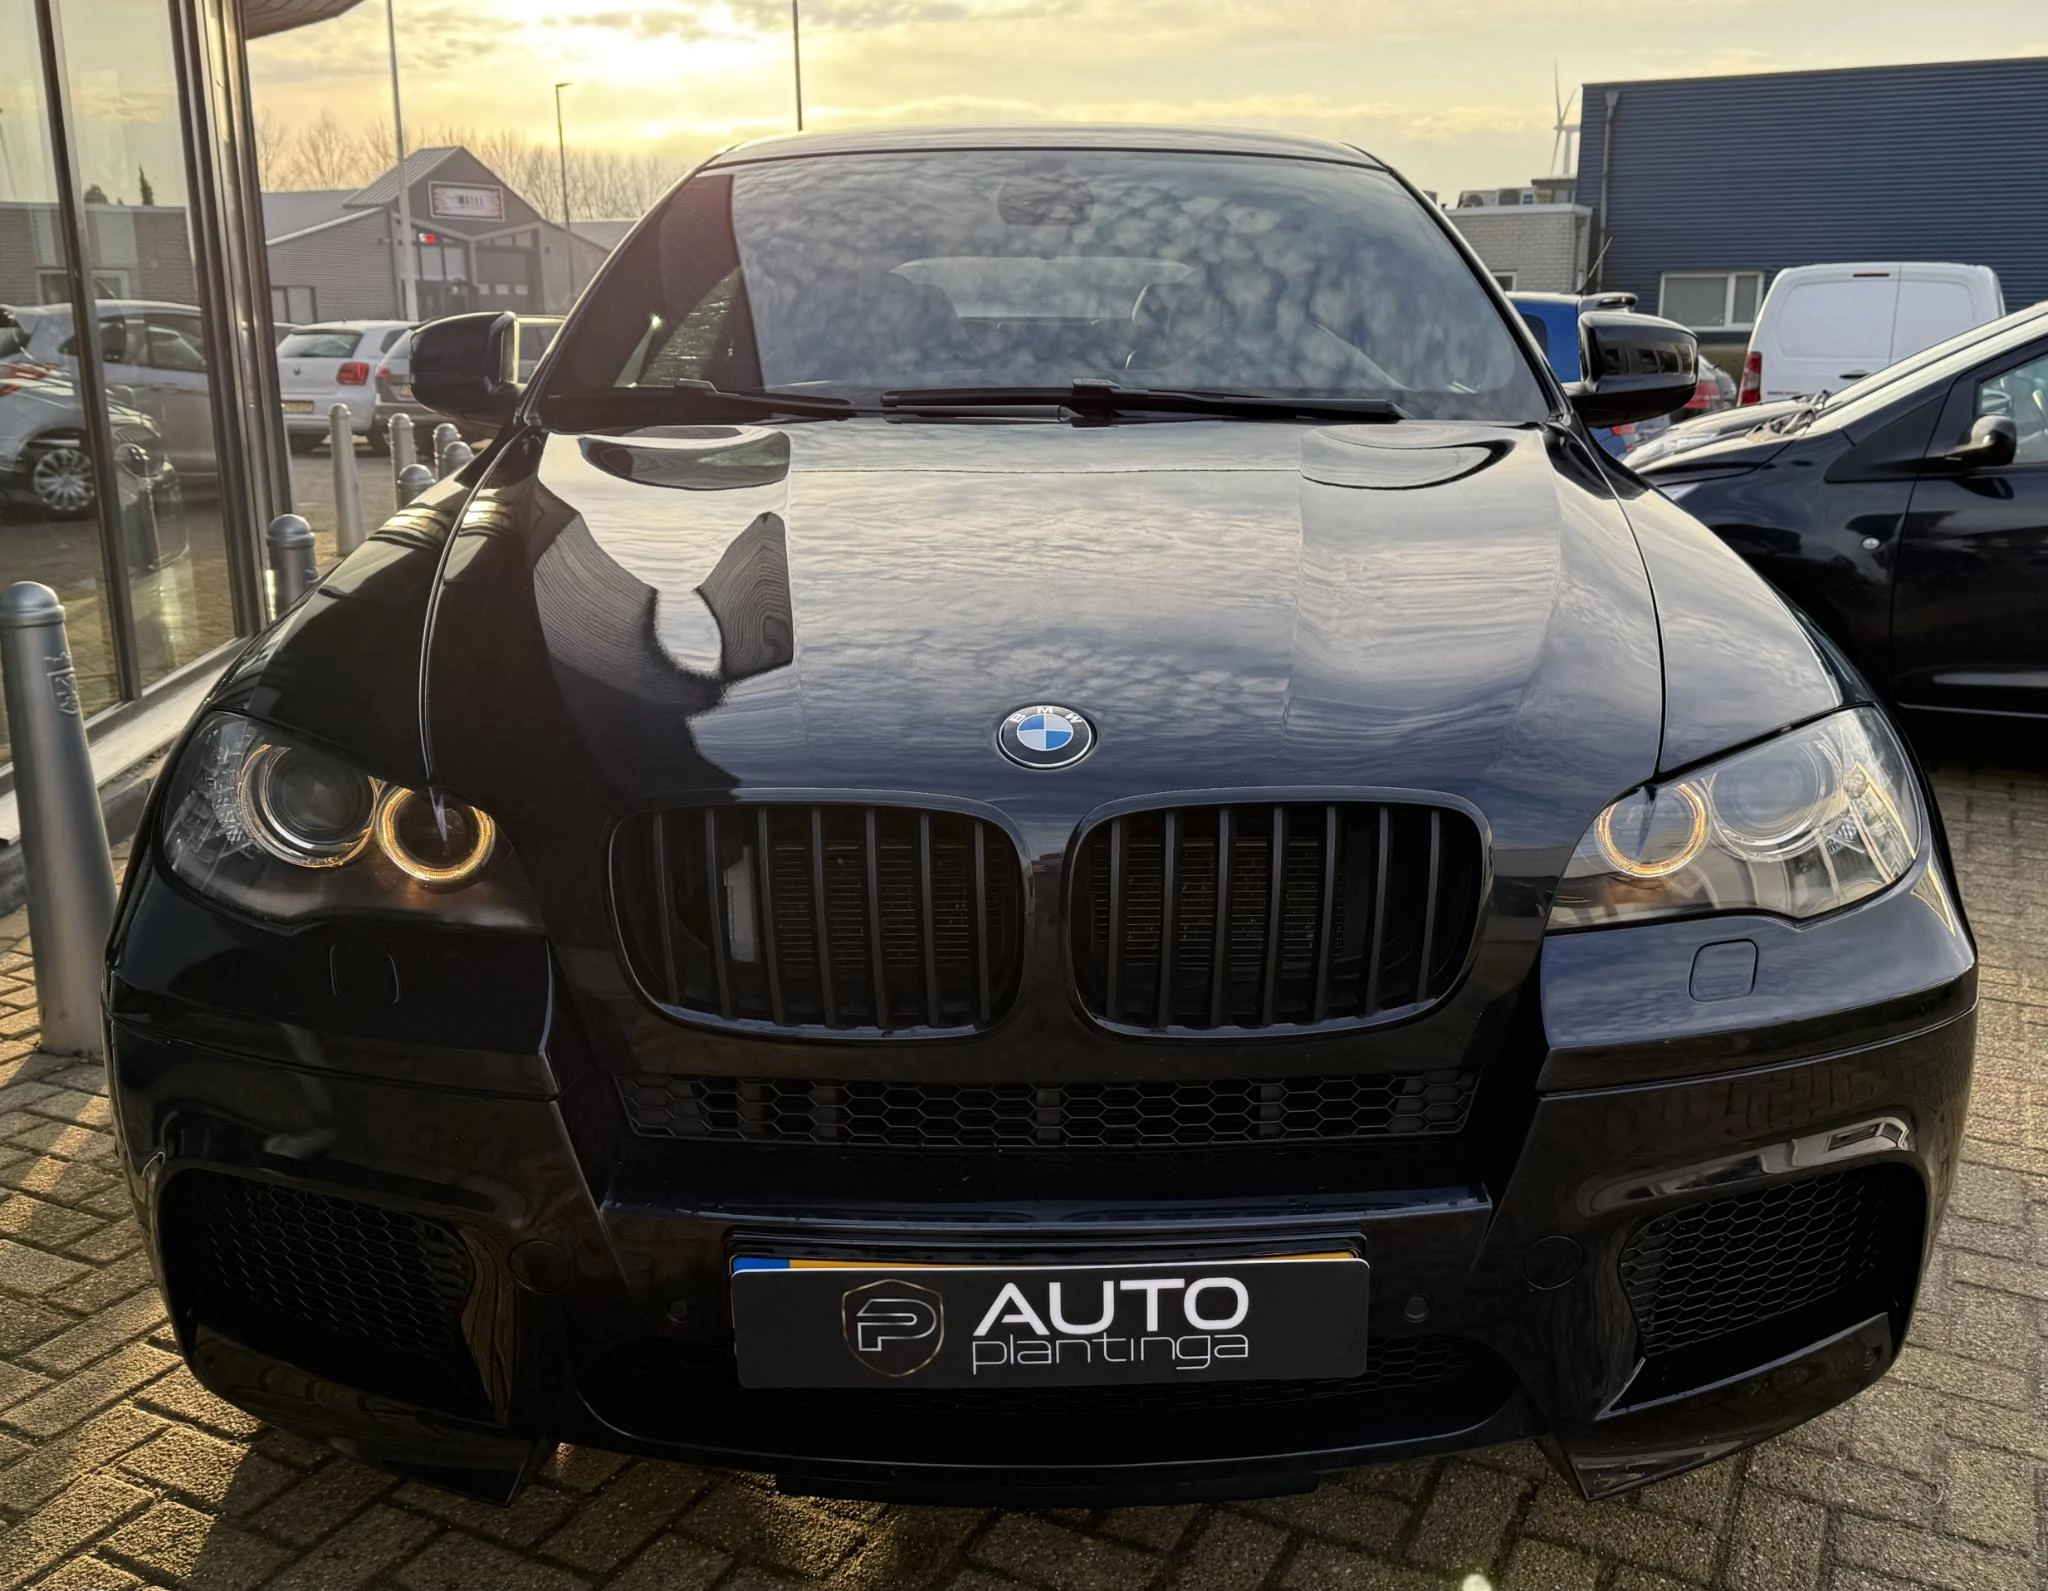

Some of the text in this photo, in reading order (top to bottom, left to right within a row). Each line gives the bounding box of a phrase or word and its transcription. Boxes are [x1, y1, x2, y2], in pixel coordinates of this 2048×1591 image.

[1009, 706, 1082, 723] BMW
[973, 1277, 1249, 1335] AUTO
[973, 1332, 1249, 1375] plantinga
